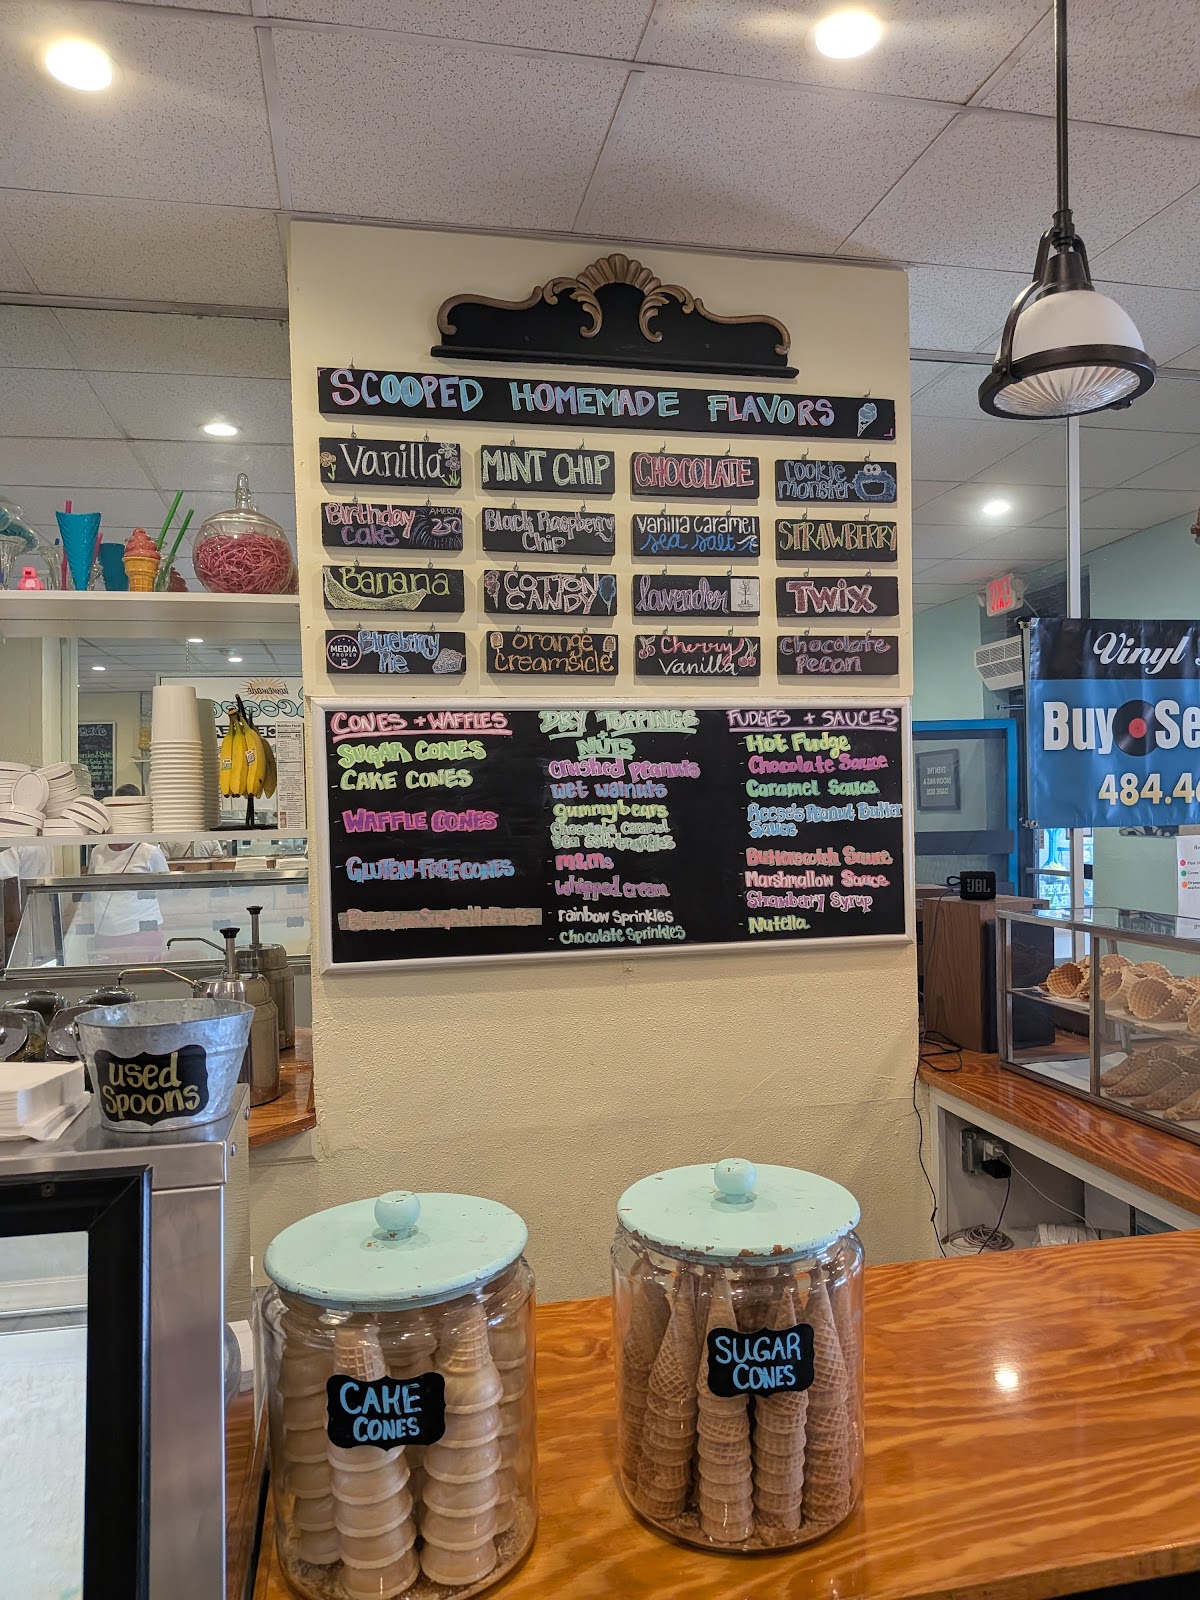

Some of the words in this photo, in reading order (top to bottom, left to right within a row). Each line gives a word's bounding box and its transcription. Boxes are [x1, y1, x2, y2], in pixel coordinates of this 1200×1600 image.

[330, 369, 483, 411] SCOOPED
[509, 381, 680, 417] HOMEMADE
[708, 394, 835, 426] FLAVORS
[338, 443, 445, 478] Vanilla
[482, 449, 549, 484] MINT
[552, 453, 611, 486] CHIP
[634, 453, 754, 489] CHOCOLATE
[325, 503, 416, 539] Birthday
[485, 509, 534, 533] Black
[536, 511, 614, 542] Raspberry
[522, 532, 566, 552] Chip
[640, 533, 688, 553] sea
[691, 533, 736, 552] salt
[779, 522, 898, 551] STRAWBERRY
[339, 566, 449, 595] Banana
[502, 571, 599, 594] COTTON
[506, 591, 598, 614] CANDY
[636, 575, 729, 613] lavender
[330, 645, 357, 653] MEDIA
[660, 635, 744, 666] Cherry
[1093, 632, 1190, 675] Vinyl
[379, 651, 410, 674] Pie
[658, 653, 738, 676] Vanilla
[330, 711, 408, 734] CONES
[538, 710, 589, 733] DRY
[595, 710, 700, 731] TOPPINGS
[726, 709, 792, 727] FUDGES
[821, 708, 900, 727] SAUCES
[1043, 701, 1118, 755] Buy
[337, 741, 413, 769] SUGAR
[414, 740, 487, 761] CONES
[576, 737, 636, 756] NUTS
[744, 733, 789, 754] Hot
[791, 731, 851, 759] Fudge
[748, 754, 836, 774] Chocolate
[839, 753, 889, 771] Sauce
[340, 769, 398, 791] CAKE
[405, 768, 474, 790] CONES
[745, 779, 821, 798] Caramel
[827, 778, 880, 796] Sauce
[1099, 772, 1200, 806] 484.4
[342, 808, 428, 833] WAFFLE
[431, 809, 499, 833] CONES
[748, 822, 798, 839] Sauce
[744, 869, 834, 889] Marshmallow
[840, 868, 891, 889] Sauce
[967, 879, 991, 893] JBL
[558, 905, 610, 923] rainbow
[830, 891, 873, 914] Syrup
[748, 915, 811, 934] Nutella
[109, 1052, 182, 1090] used
[715, 1332, 801, 1364] SUGAR
[733, 1364, 797, 1389] CONES
[340, 1382, 422, 1415] CAKE
[353, 1416, 420, 1442] CONES
